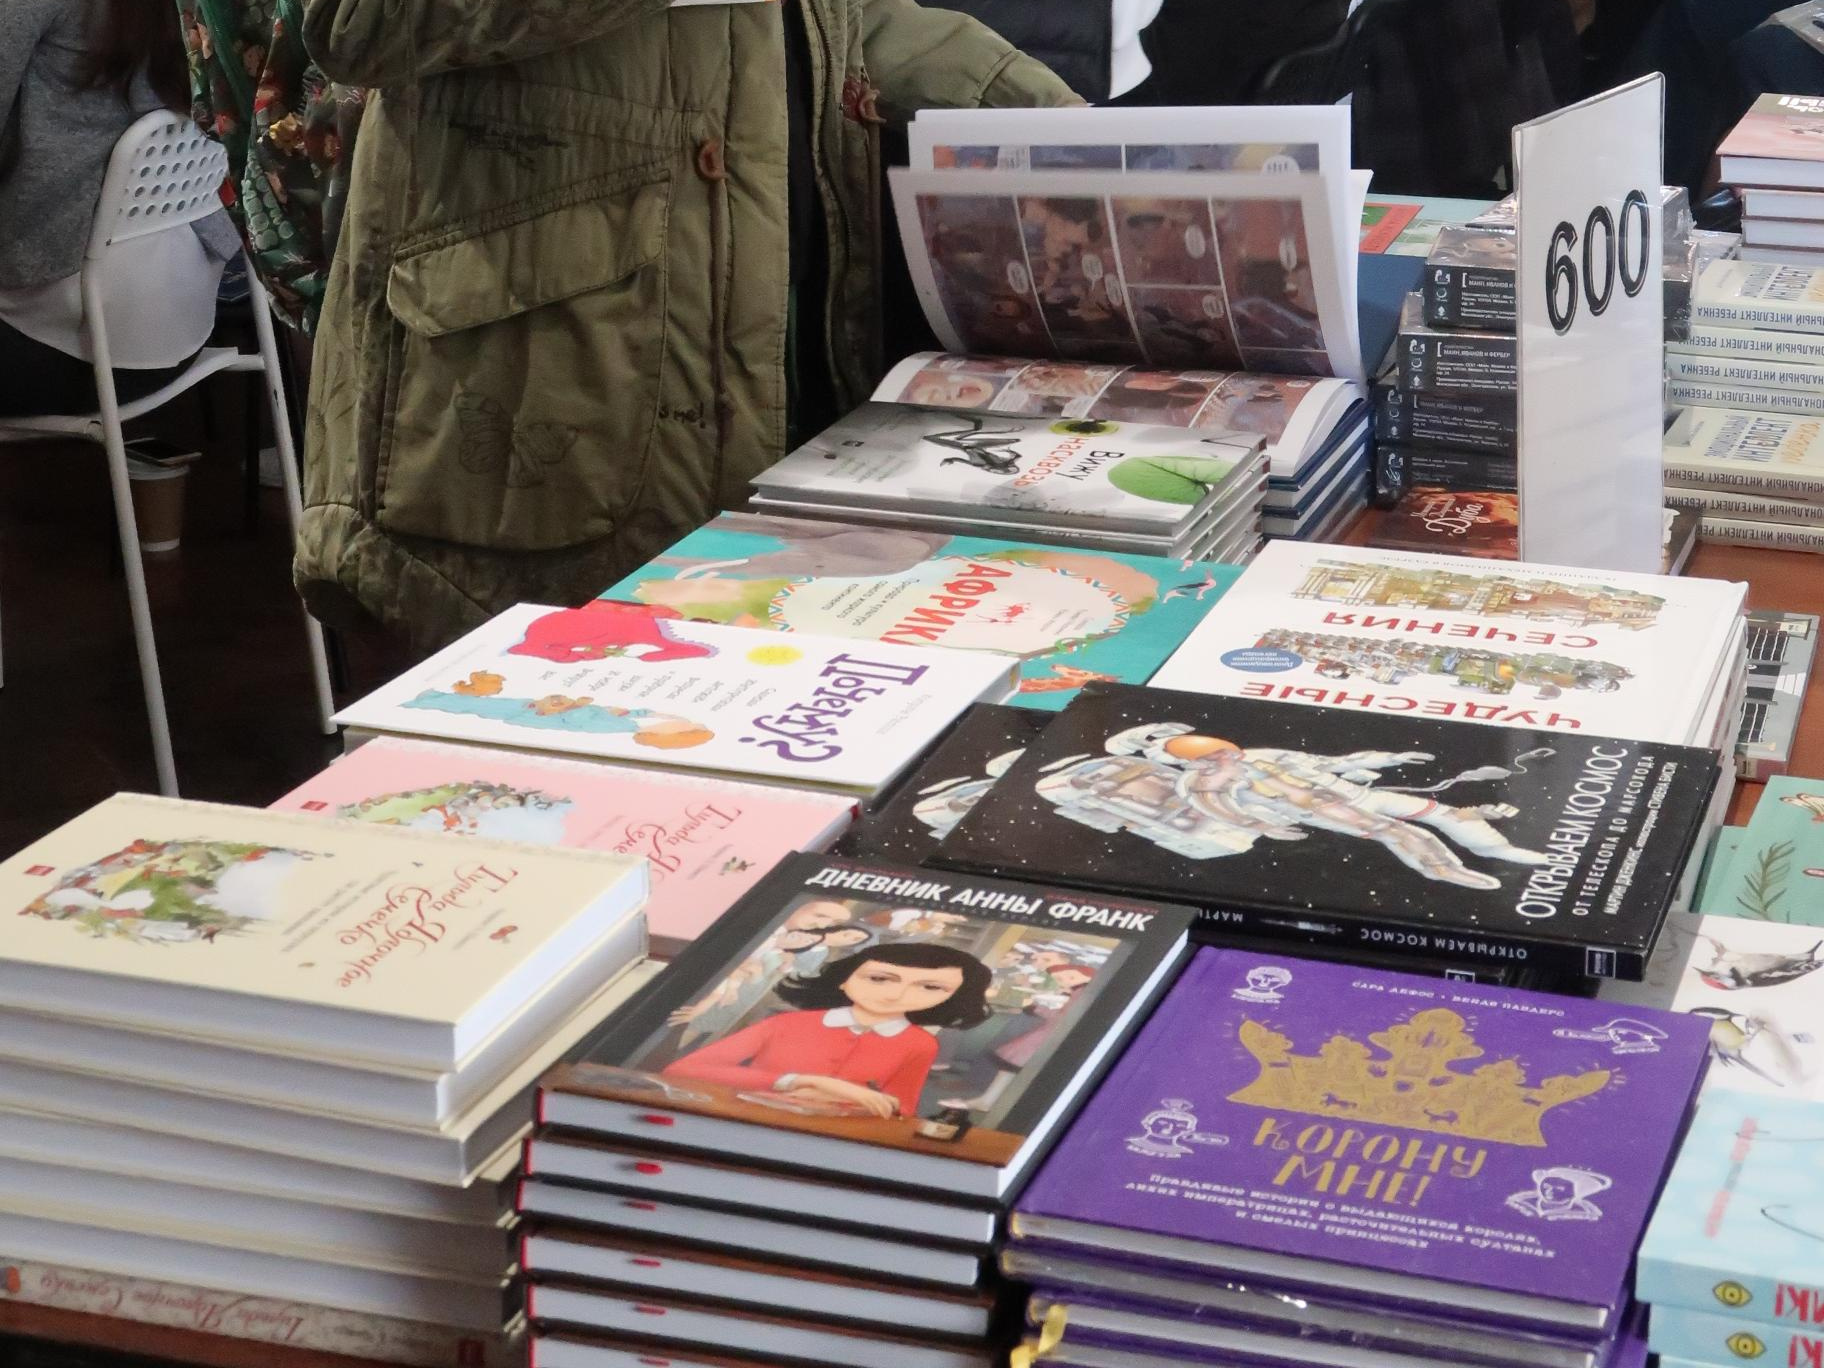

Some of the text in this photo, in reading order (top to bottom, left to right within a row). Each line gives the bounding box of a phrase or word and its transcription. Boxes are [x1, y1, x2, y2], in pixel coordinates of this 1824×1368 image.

[1545, 189, 1650, 337] 600
[1056, 449, 1126, 482] Вижу
[1322, 610, 1599, 649] СЕЧЕНИЯ
[738, 653, 929, 762] Почему?
[1240, 681, 1582, 730] ЧУДЕСНЫЕ
[1515, 745, 1629, 919] ОТКРЫВАЕМ КОСМОС
[1571, 755, 1656, 917] ОТ ТЕЛЕСКОПА ДО МАРСОХОДА
[805, 867, 951, 902] ДНЕВНИК
[950, 887, 1043, 916] АННЫ
[1049, 900, 1155, 932] ФРАНК
[1360, 928, 1428, 948] КОСМОС
[1434, 938, 1528, 960] ОТКРЫВАЕМ
[1250, 1116, 1488, 1178] КОРОНУ
[1272, 1154, 1431, 1208] МНЕ!
